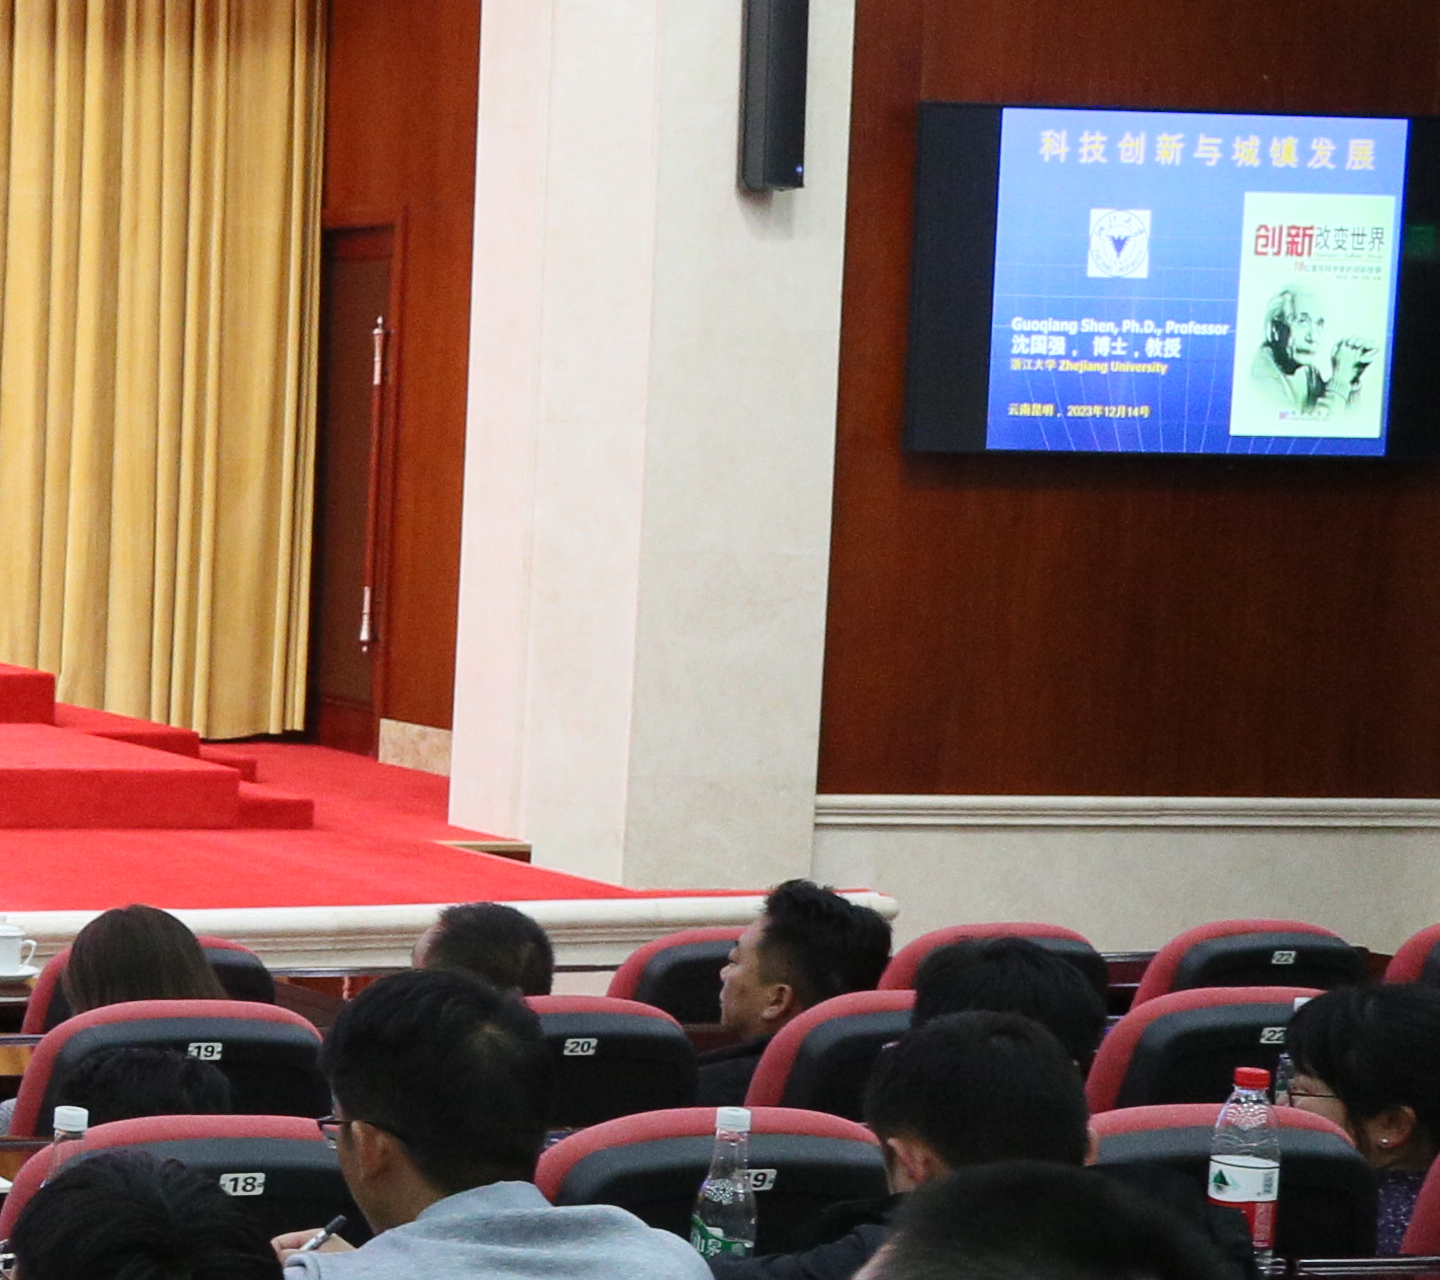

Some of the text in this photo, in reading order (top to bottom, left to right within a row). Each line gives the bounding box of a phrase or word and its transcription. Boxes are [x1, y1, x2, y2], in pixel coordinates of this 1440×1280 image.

[1038, 129, 1377, 171] 科技创新与城镇发展
[1011, 317, 1229, 336] Guoqiang Shen, Ph.D., Professor
[1058, 360, 1108, 374] Zhejiang
[1111, 361, 1168, 375] University
[1275, 952, 1292, 962] 22
[1264, 1029, 1285, 1041] 22
[195, 1044, 215, 1057] 19
[568, 1040, 590, 1053] 20
[228, 1175, 255, 1192] 18
